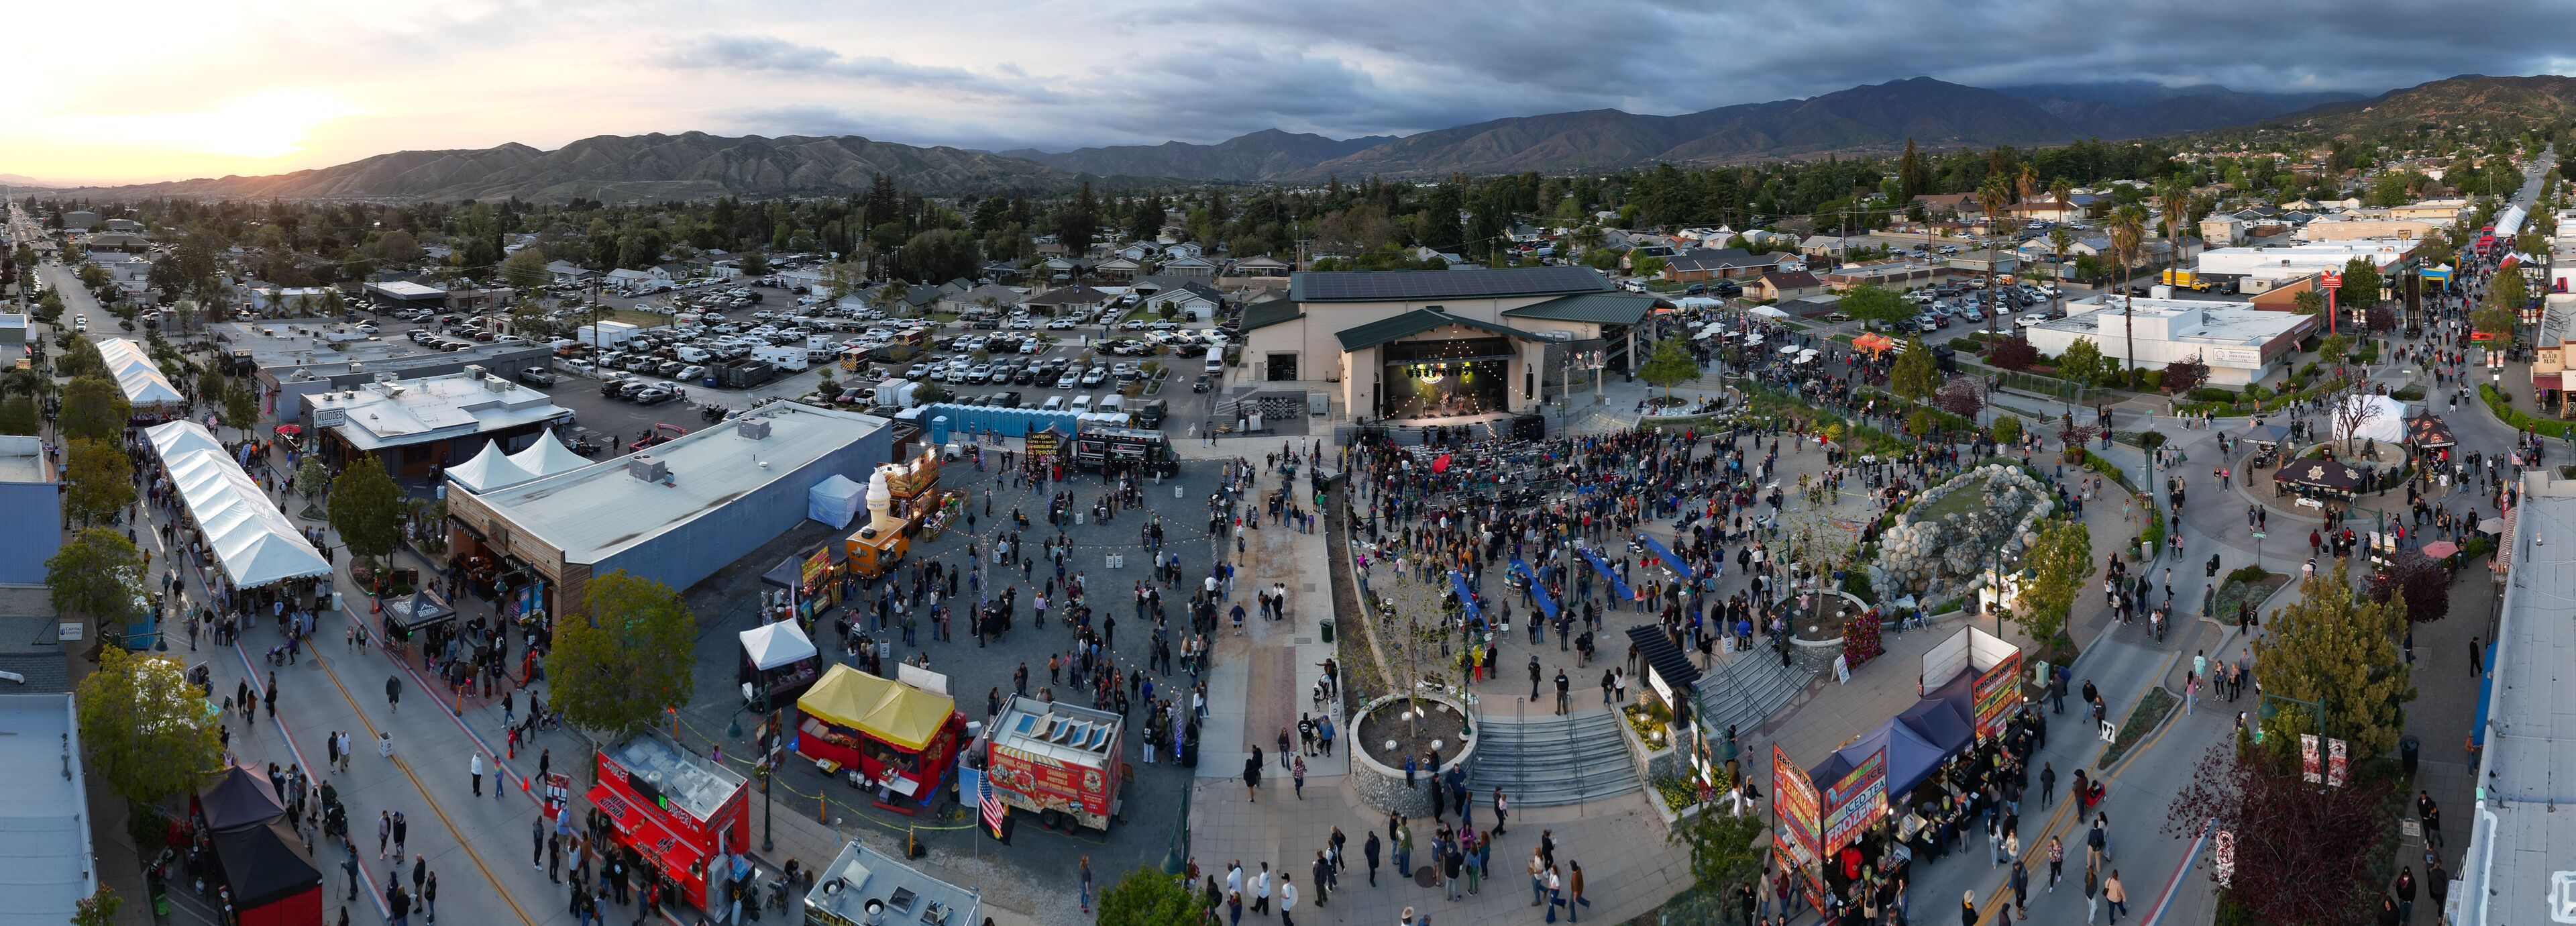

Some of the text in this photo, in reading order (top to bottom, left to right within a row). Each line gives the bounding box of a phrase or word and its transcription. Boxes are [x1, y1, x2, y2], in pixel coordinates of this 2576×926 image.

[318, 410, 343, 421] KLUDDES
[1976, 672, 1998, 693] BACON
[1999, 658, 2018, 674] WRAP
[1984, 690, 2015, 722] LEMONADE
[1777, 752, 1802, 780] BACON
[1838, 752, 1882, 792] HAWAIIAN
[608, 794, 629, 811] METAL
[1782, 778, 1814, 822] LEMONADE
[1838, 765, 1883, 805] SHAVE ICE
[1845, 780, 1885, 815] ICED TEA
[598, 797, 625, 819] KITCHEN
[1826, 796, 1876, 845] FROZEN
[1827, 803, 1888, 857] LEMONADE
